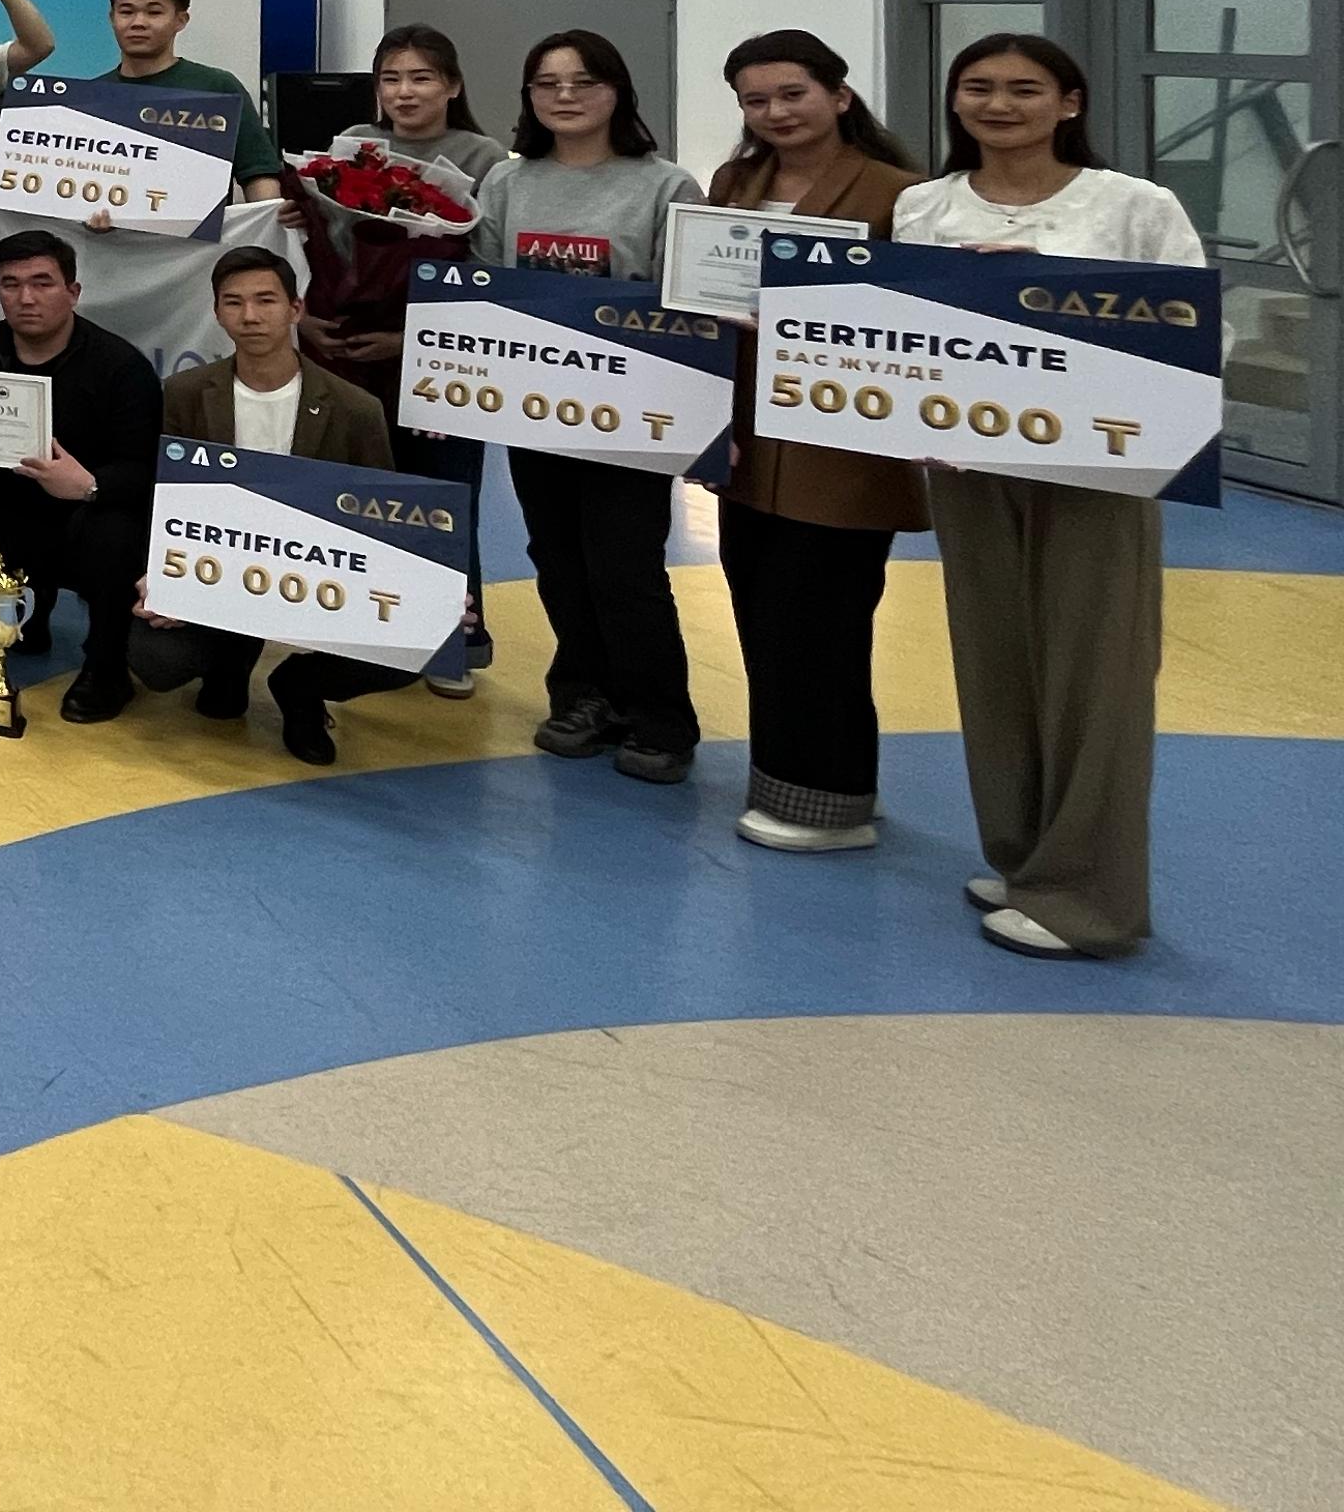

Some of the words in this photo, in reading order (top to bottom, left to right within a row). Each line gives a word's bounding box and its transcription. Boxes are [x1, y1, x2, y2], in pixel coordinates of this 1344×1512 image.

[6, 128, 160, 161] CERTIFICATE
[0, 169, 44, 194] 50
[56, 176, 130, 207] 000
[528, 239, 599, 261] АЛАШ
[708, 244, 759, 261] ДИП
[417, 329, 627, 375] CERTIFICATE
[775, 317, 1068, 373] CERTIFICATE
[775, 348, 828, 369] БАС
[429, 359, 489, 378] ОРЫН
[412, 376, 504, 413] 400
[522, 392, 620, 433] 000
[768, 372, 894, 421] 500
[918, 393, 1063, 446] 000
[164, 518, 367, 574] CERTIFICATE
[162, 548, 223, 585] 50
[242, 565, 348, 611] 000
